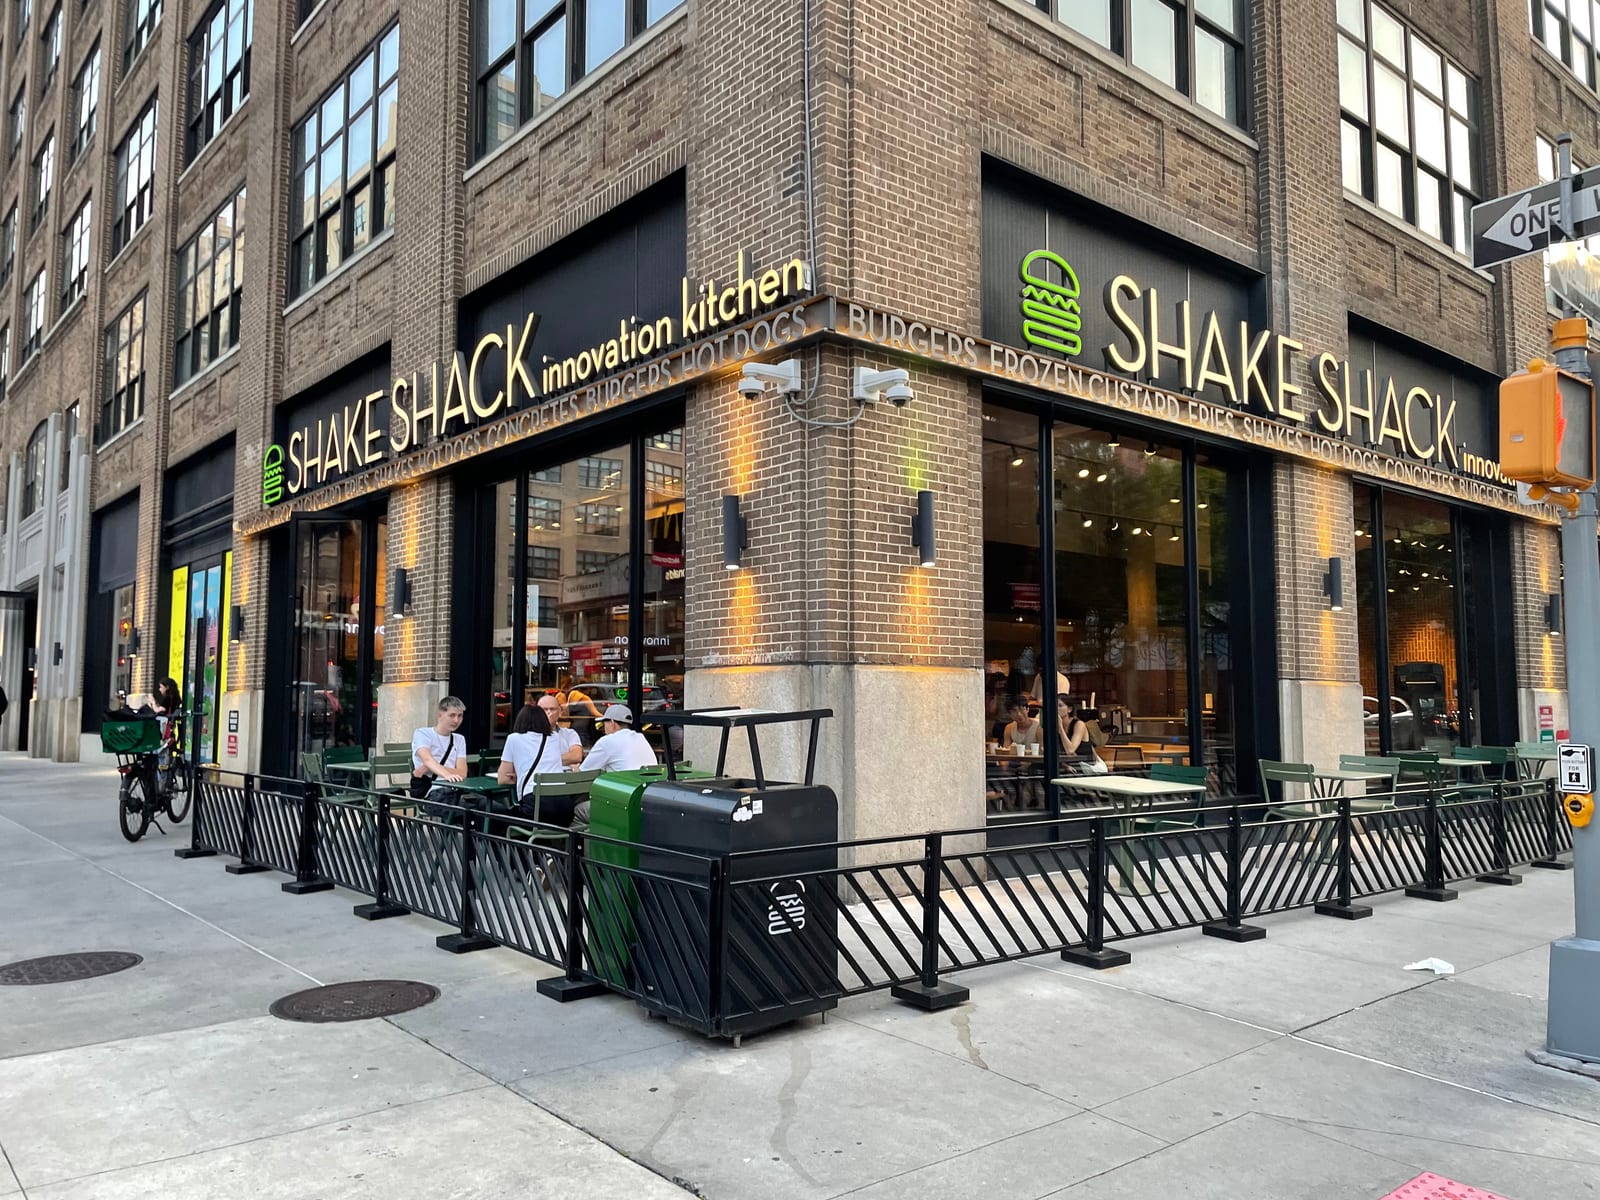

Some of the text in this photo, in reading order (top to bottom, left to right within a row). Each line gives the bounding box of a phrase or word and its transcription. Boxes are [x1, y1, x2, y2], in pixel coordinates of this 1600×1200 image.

[1510, 201, 1561, 237] ONE
[287, 312, 536, 494] SHAKE SHACK
[344, 474, 370, 500] FRIES
[374, 457, 414, 487] SHAKES
[418, 446, 443, 472] HOT
[444, 431, 481, 463] DOGS
[487, 394, 579, 448] CONCRETES
[585, 357, 672, 411] BURGERS
[682, 334, 728, 378] HOT
[734, 305, 808, 361] DOGS
[542, 249, 803, 395] innovation kitchen
[849, 304, 978, 368] BURGERS
[990, 344, 1083, 395] FROZEN
[1089, 376, 1180, 422] CUSTARD
[1188, 400, 1235, 435] FRIES
[1242, 417, 1305, 456] SHAKES
[1310, 434, 1343, 466] HOT
[1342, 446, 1380, 475] DOGS
[1385, 458, 1455, 494] CONCRETES
[1459, 479, 1503, 507] BURGERS
[1108, 274, 1459, 468] SHAKE SHACK
[1463, 442, 1518, 486] innov
